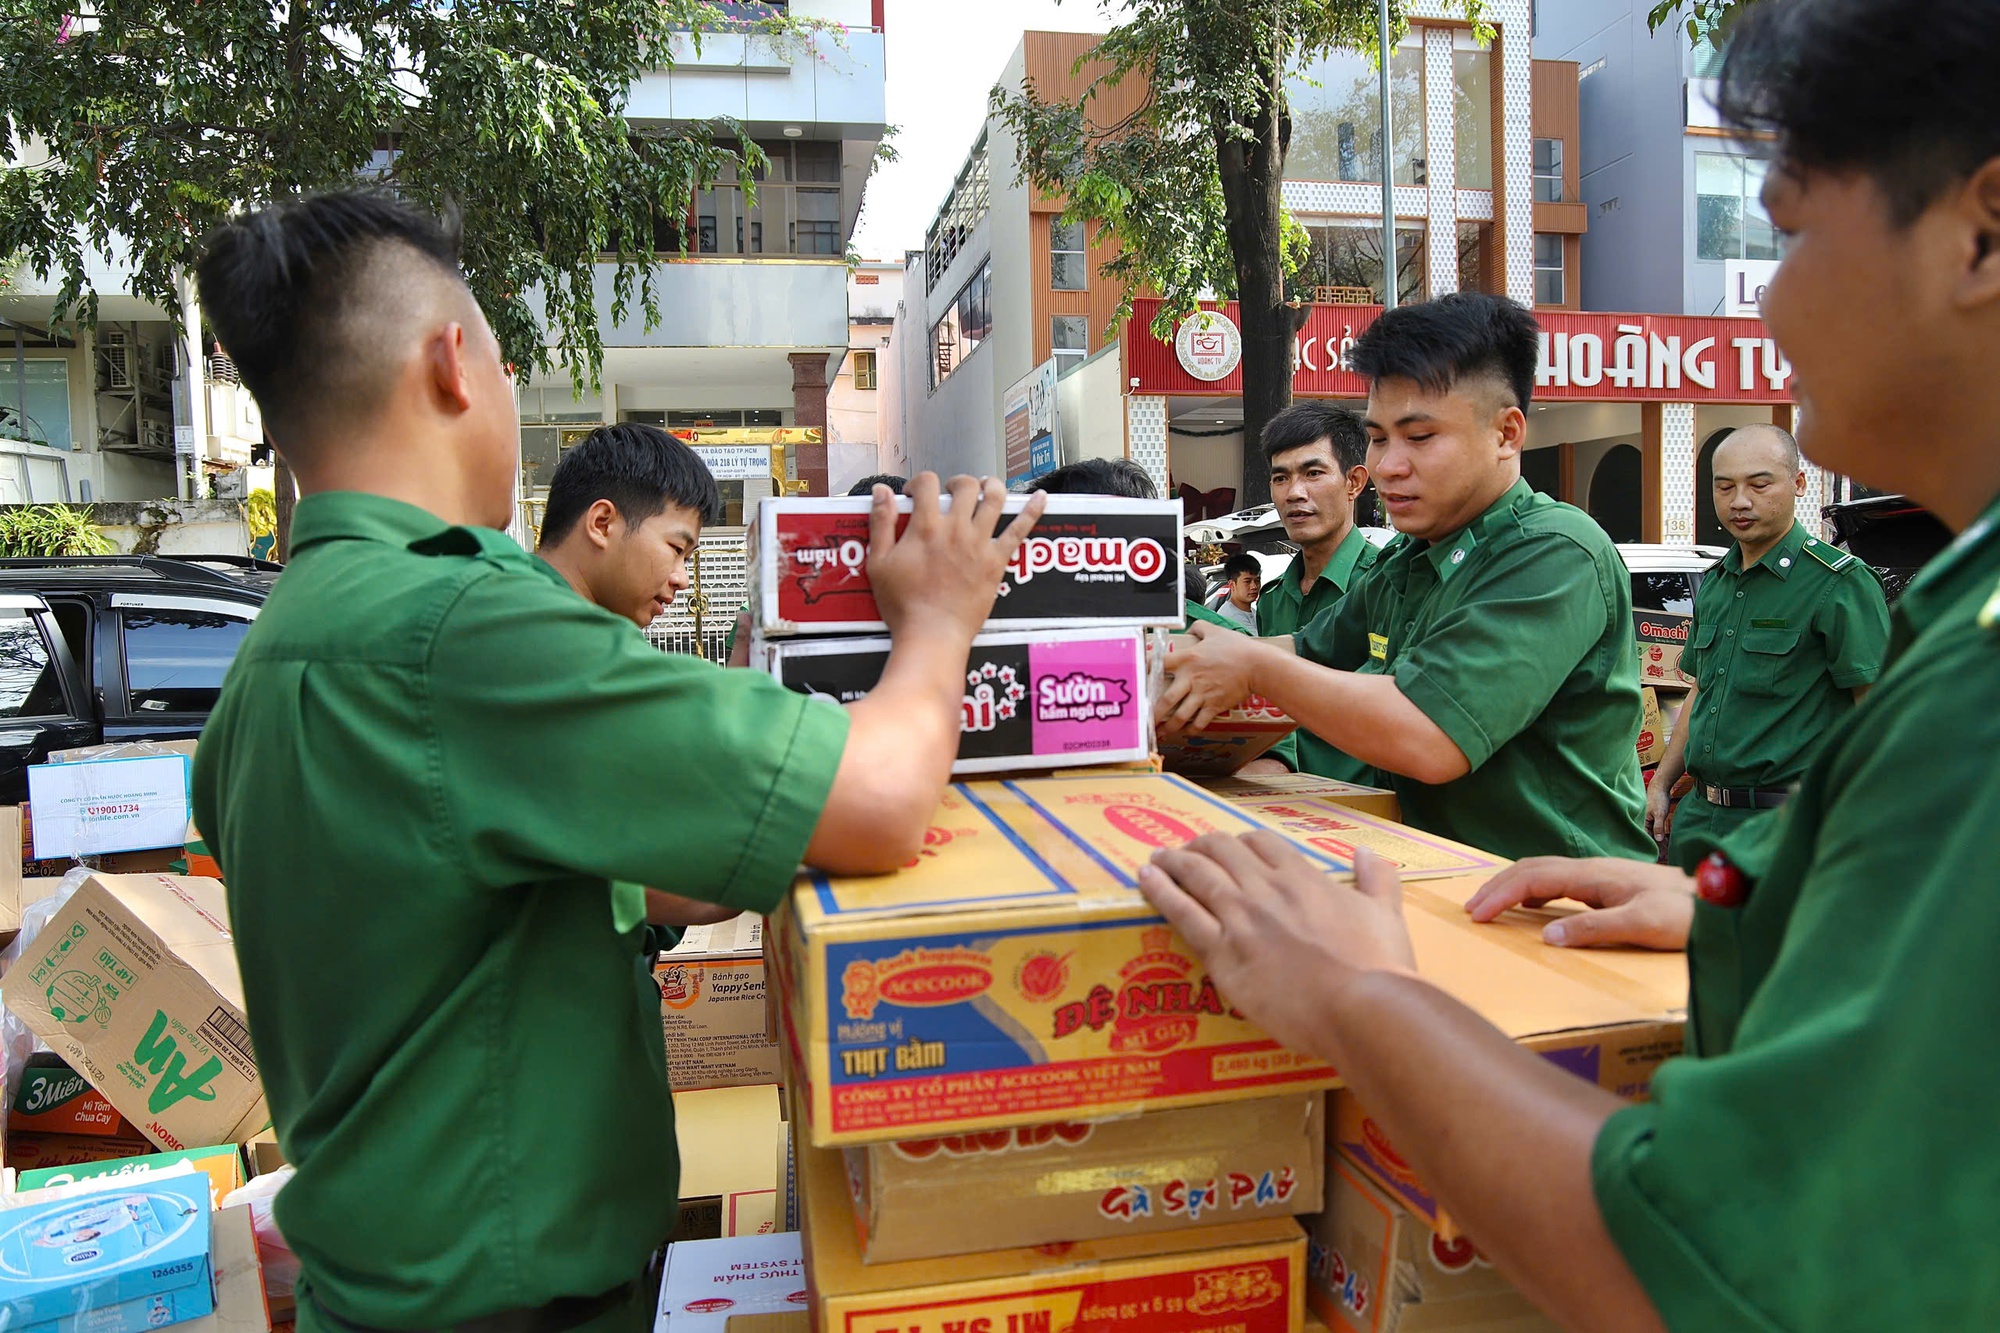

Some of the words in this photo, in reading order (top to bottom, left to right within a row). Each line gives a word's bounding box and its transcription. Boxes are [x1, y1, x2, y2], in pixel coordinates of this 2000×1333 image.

[1534, 324, 1716, 389] HOÀNG
[1671, 520, 1686, 531] 38
[1640, 621, 1688, 640] Omachi
[1038, 677, 1106, 705] Sườn
[712, 972, 732, 981] Bánh
[734, 973, 750, 982] gạo
[712, 983, 742, 994] Yappy
[838, 1088, 888, 1105] CÔNG
[893, 1085, 914, 1100] TY
[1000, 1070, 1080, 1091] ACECOOK
[1125, 1060, 1161, 1077] NAM
[82, 1101, 93, 1110] Mì
[94, 1100, 110, 1112] Tôm
[74, 1112, 95, 1122] Chua
[96, 1113, 112, 1124] Cay
[1100, 1184, 1149, 1223] Gà
[1162, 1176, 1217, 1219] Sợi
[1227, 1166, 1296, 1207] Phở
[152, 1262, 194, 1280] 1266355
[730, 1260, 788, 1271] SYSTEM
[760, 1268, 800, 1279] THỰC
